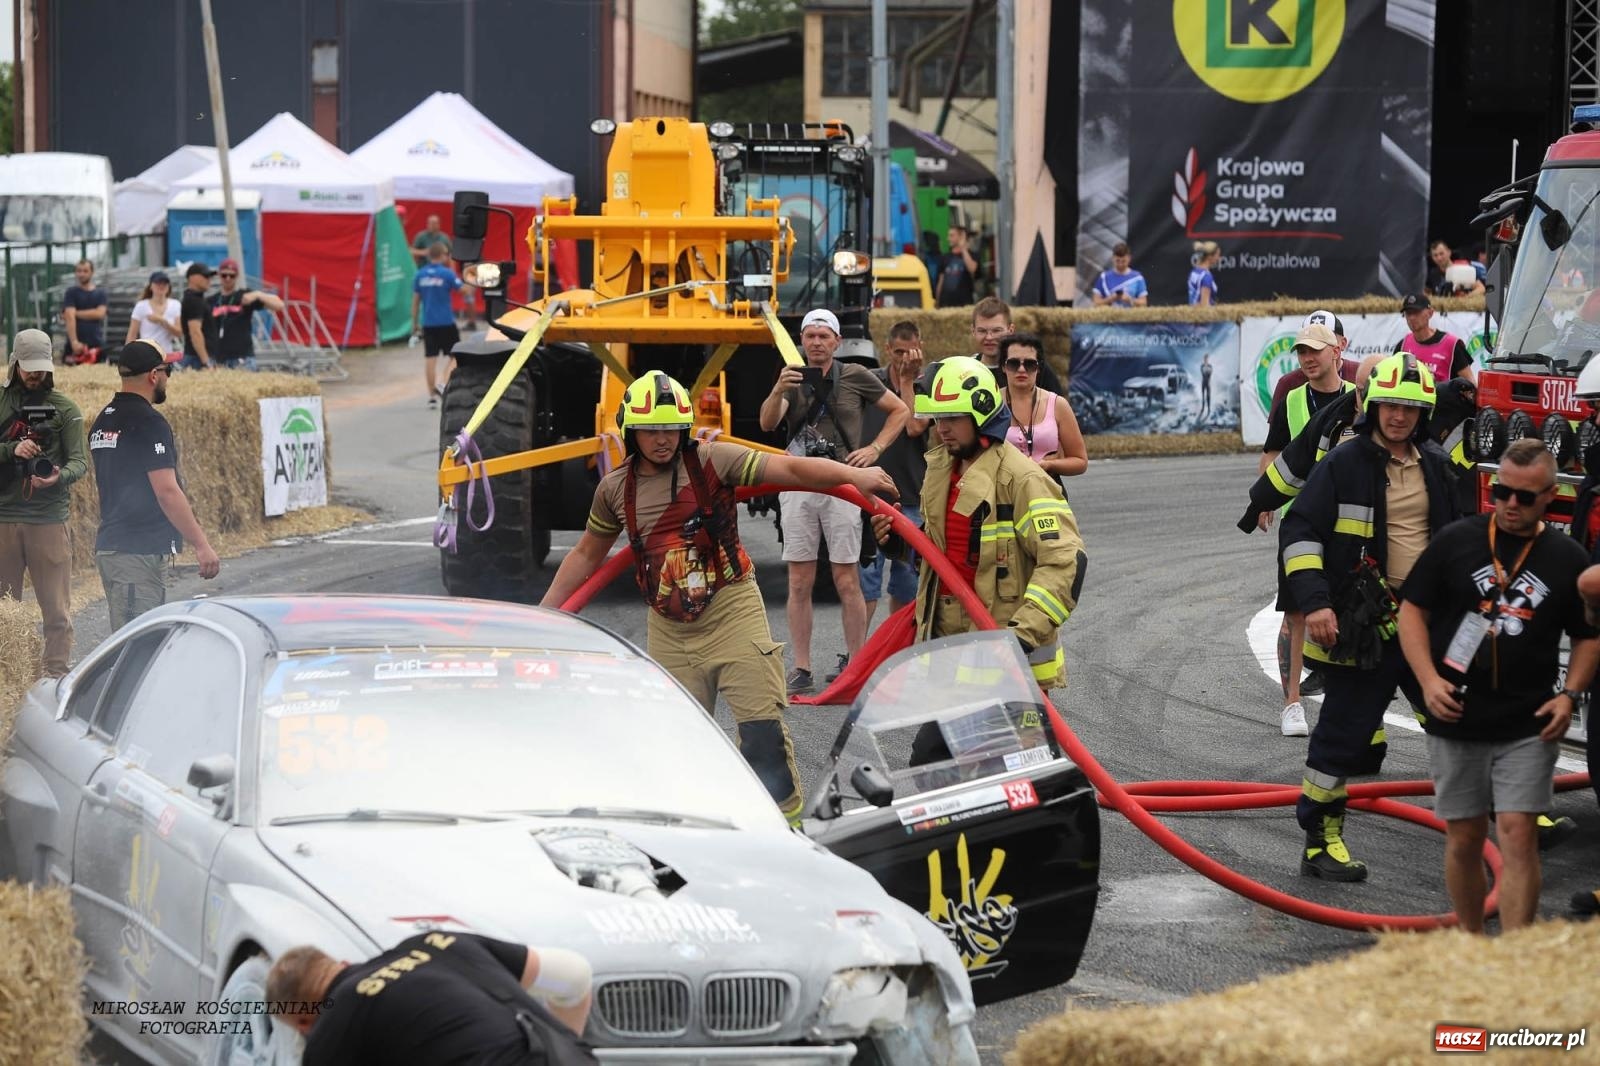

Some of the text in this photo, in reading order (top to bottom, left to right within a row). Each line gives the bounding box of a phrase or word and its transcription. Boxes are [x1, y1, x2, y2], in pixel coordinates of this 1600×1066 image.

[1230, 0, 1293, 45] K
[1217, 157, 1305, 180] Krajowa
[1216, 181, 1285, 203] Grupa
[1214, 203, 1337, 227] Spożywcza
[1190, 252, 1321, 271] Gpa Kapitałowa
[1037, 518, 1055, 529] OSP
[523, 662, 551, 674] 74
[1008, 783, 1034, 806] 532
